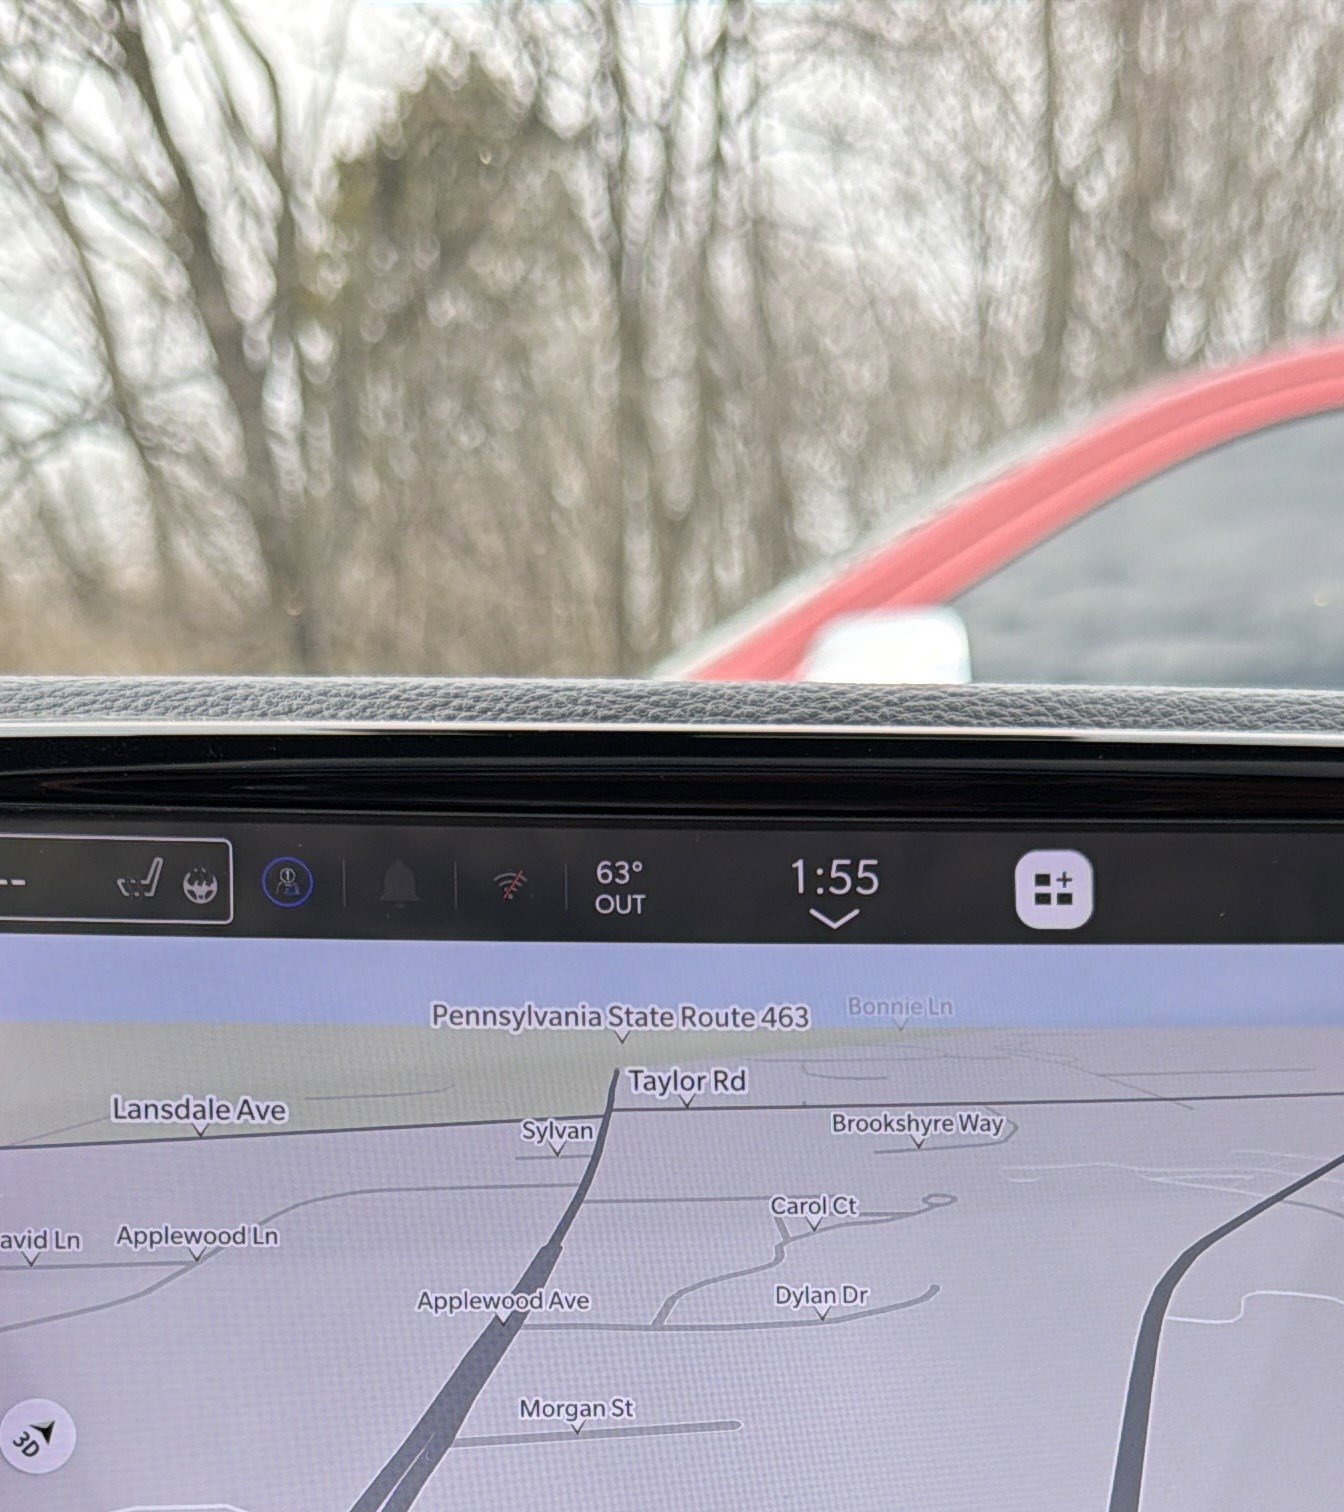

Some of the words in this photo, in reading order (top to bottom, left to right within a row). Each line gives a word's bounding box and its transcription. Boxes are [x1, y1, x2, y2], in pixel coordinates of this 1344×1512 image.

[596, 860, 644, 887] 63°
[792, 859, 880, 894] 1:55
[595, 894, 646, 915] OUT
[432, 1004, 604, 1031] Pennsylvania
[609, 1005, 675, 1029] State
[680, 1006, 757, 1029] Route
[760, 1006, 810, 1029] 463
[848, 997, 923, 1016] Bonnie
[927, 997, 954, 1016] Ln
[629, 1069, 707, 1094] Taylor
[713, 1069, 747, 1091] Rd
[112, 1098, 232, 1122] Lansdale
[235, 1098, 288, 1122] Ave
[522, 1121, 594, 1144] Sylvan
[832, 1113, 955, 1138] Brookshyre
[958, 1113, 1004, 1138] Way
[772, 1195, 827, 1215] Carol
[832, 1195, 858, 1215] Ct
[53, 1230, 80, 1250] Ln
[116, 1225, 248, 1250] Applewood
[252, 1226, 279, 1246] Ln
[417, 1290, 542, 1315] Applewood
[547, 1290, 590, 1310] Ave
[775, 1285, 835, 1308] Dylan
[840, 1285, 867, 1305] Dr
[520, 1398, 604, 1423] Morgan
[609, 1398, 634, 1419] St
[12, 1430, 40, 1458] 3D
